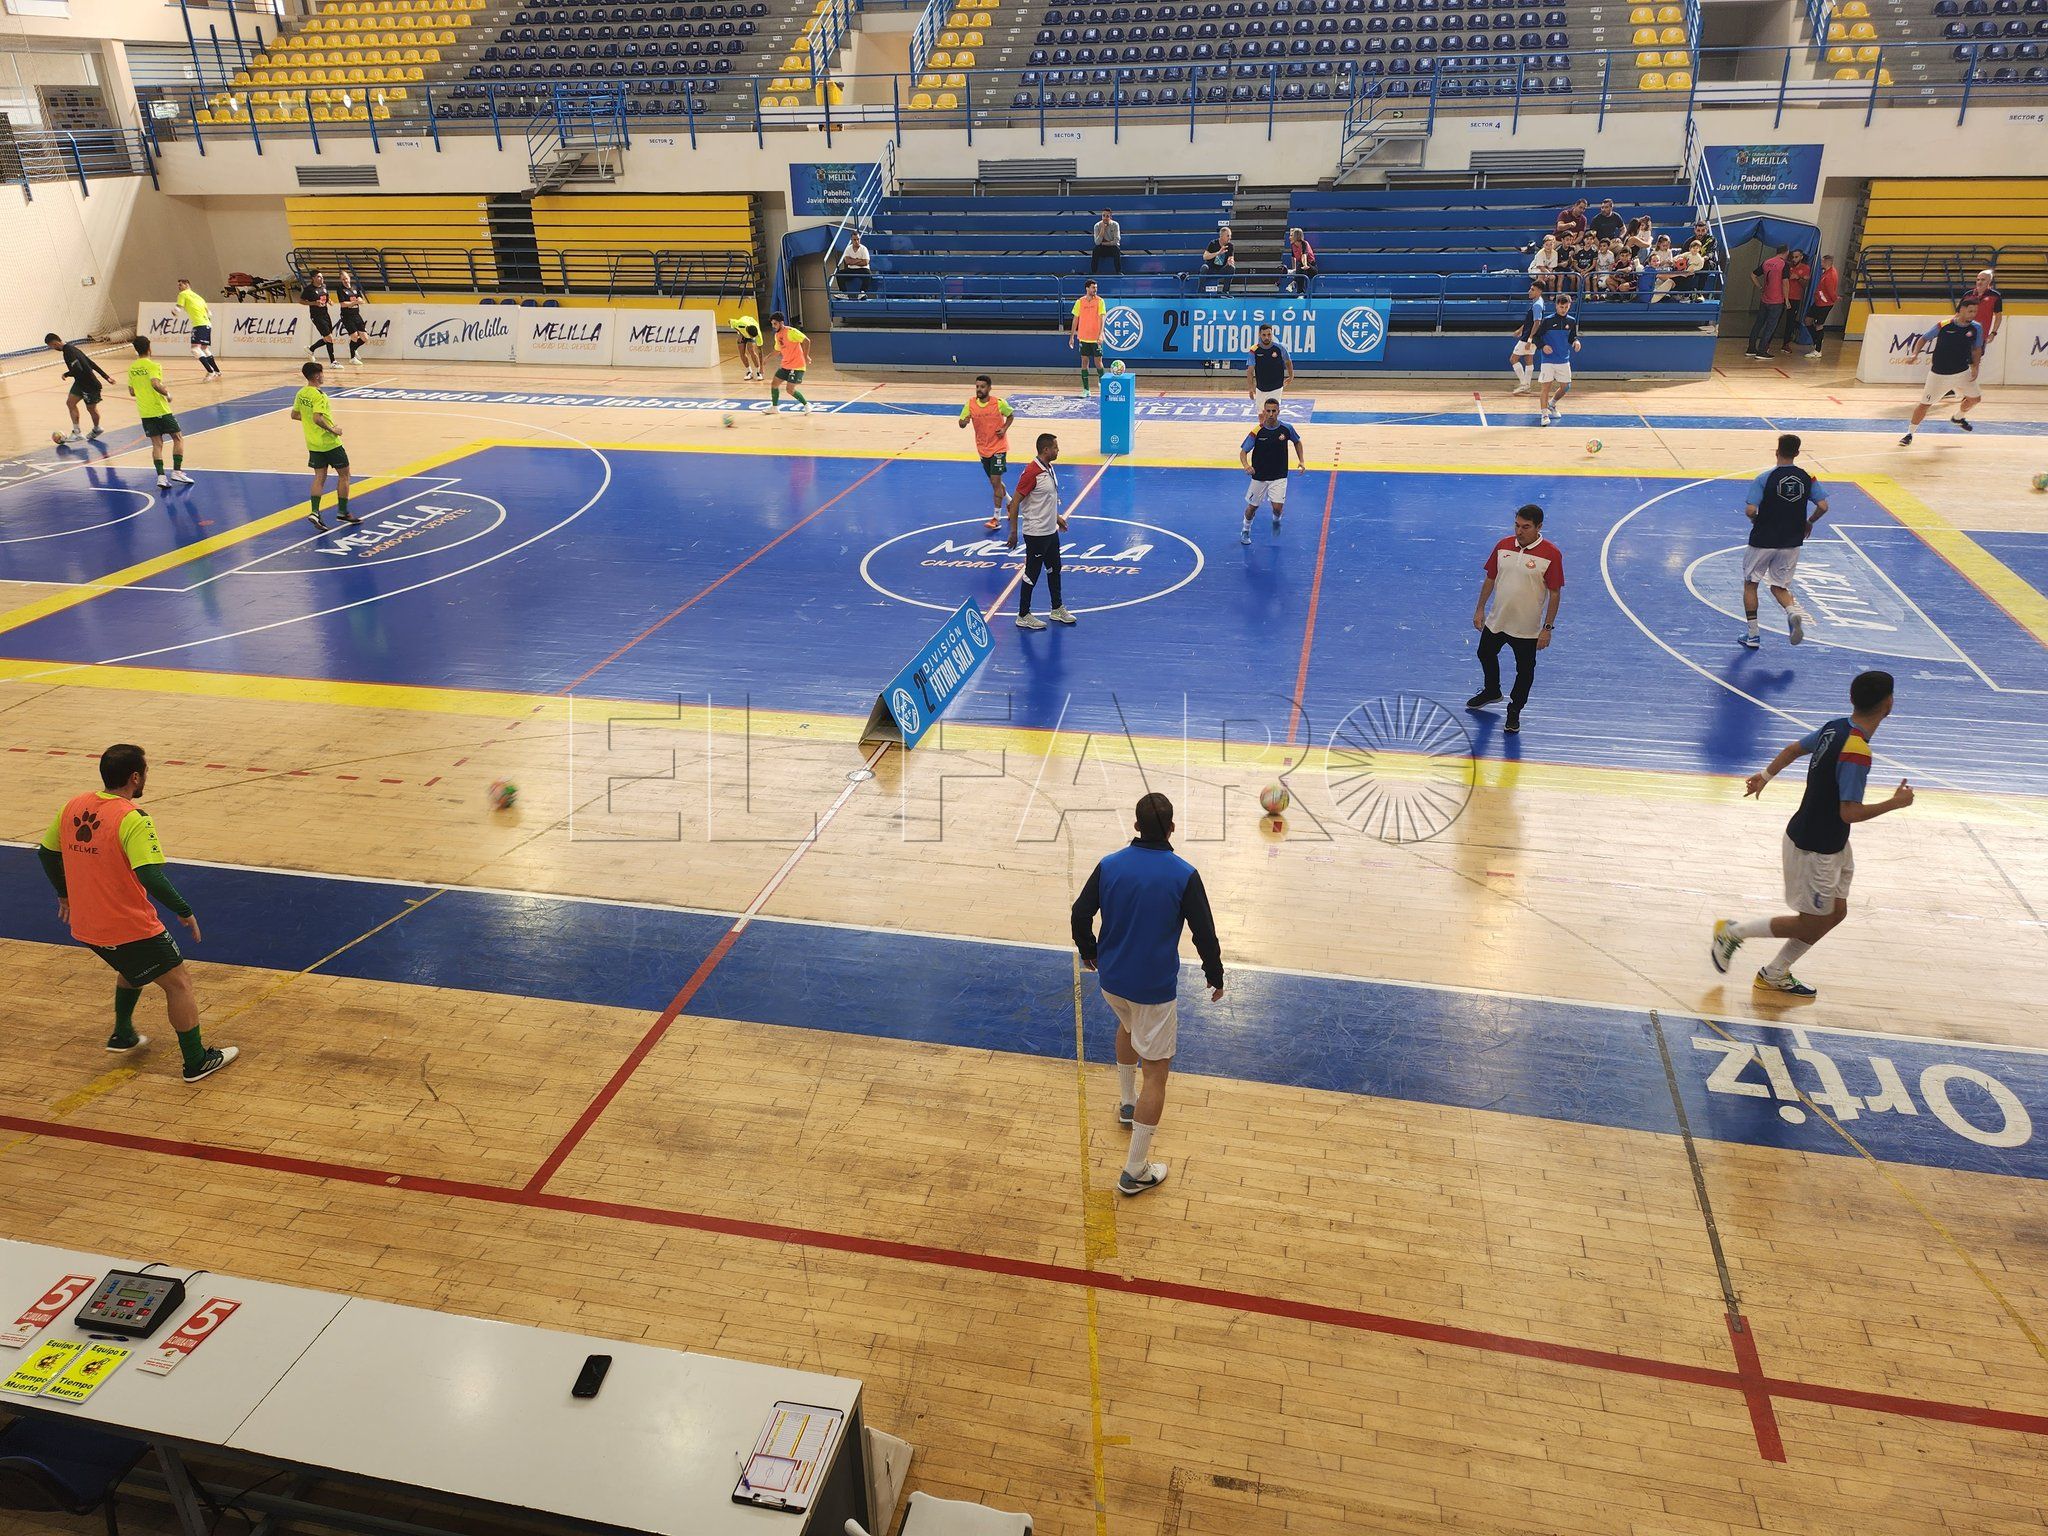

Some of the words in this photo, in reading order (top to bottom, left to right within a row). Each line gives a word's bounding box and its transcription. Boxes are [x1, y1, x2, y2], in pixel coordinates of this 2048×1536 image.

[2037, 114, 2044, 122] 5
[1751, 157, 1788, 165] MELILLA
[1716, 183, 1741, 191] Javier
[1742, 183, 1776, 191] Imbroda
[1778, 182, 1798, 190] Ortiz
[1740, 174, 1776, 182] Pabellón
[1193, 306, 1316, 322] DIVISIÓN
[149, 317, 191, 335] MELIL
[233, 316, 298, 335] MELILLA
[417, 330, 450, 348] VEN
[453, 335, 460, 344] A
[461, 316, 509, 343] Melilla
[533, 321, 603, 342] MELILLA
[629, 324, 701, 345] MELILLA
[347, 388, 489, 401] Pabellón
[485, 393, 594, 406] Javier
[593, 397, 741, 410] Imbroda
[315, 504, 454, 556] MELILLA
[926, 538, 1154, 562] MELLLA
[920, 559, 998, 569] CIUDAD
[1060, 564, 1142, 575] EPORTE
[922, 625, 962, 675] DIVISIÓN
[928, 655, 962, 703] FÚTBOL
[951, 638, 976, 674] SALA
[68, 844, 100, 855] KELME
[1690, 1036, 2033, 1148] Ortiz
[35, 1278, 90, 1311] 5
[181, 1301, 235, 1336] 5
[46, 1339, 74, 1350] Equipo
[91, 1344, 119, 1356] Equipo
[13, 1371, 48, 1383] Tiempo
[59, 1376, 94, 1390] Tiempo
[4, 1380, 38, 1392] Muerto
[49, 1386, 84, 1398] Muerto
